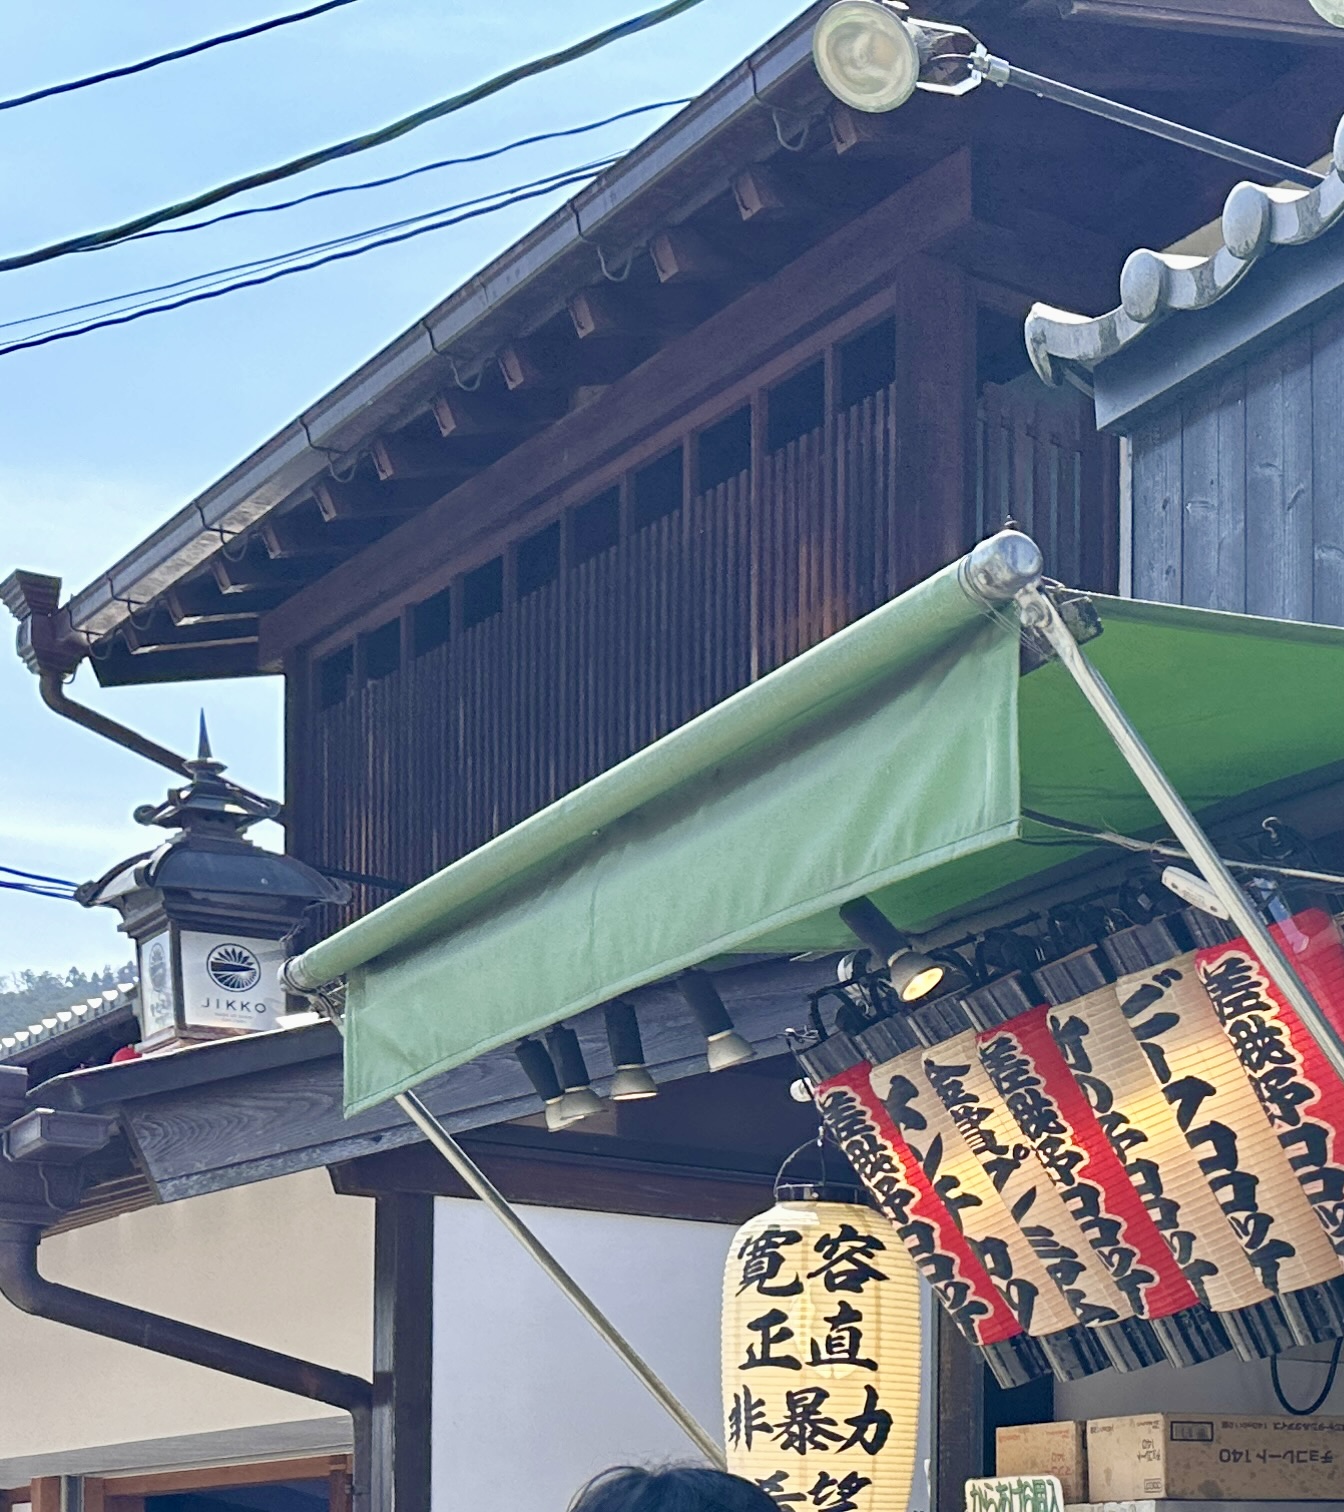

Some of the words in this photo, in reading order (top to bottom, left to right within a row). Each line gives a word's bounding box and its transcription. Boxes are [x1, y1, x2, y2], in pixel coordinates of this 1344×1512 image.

[201, 997, 267, 1014] JIKKO
[738, 1300, 880, 1372] 正直
[728, 1383, 894, 1456] 非暴力
